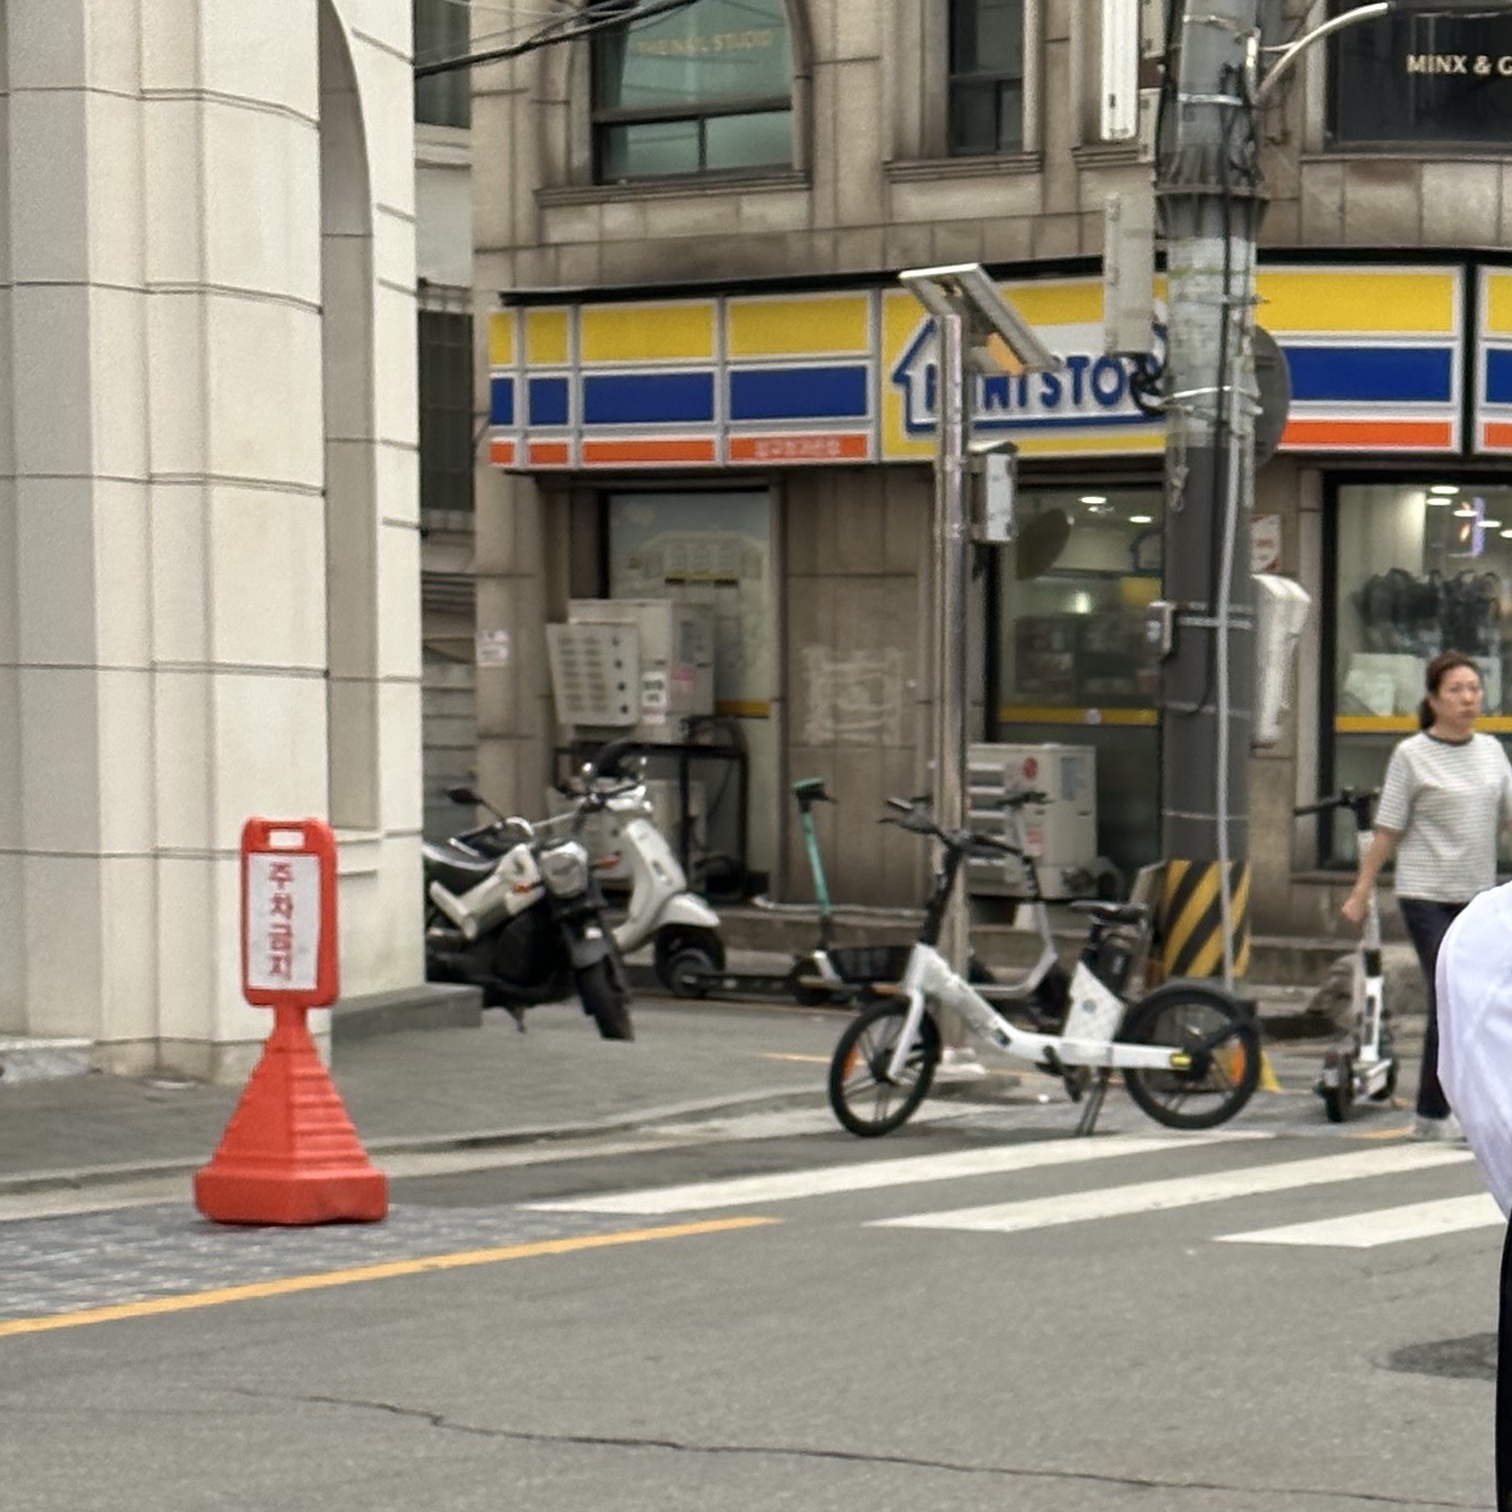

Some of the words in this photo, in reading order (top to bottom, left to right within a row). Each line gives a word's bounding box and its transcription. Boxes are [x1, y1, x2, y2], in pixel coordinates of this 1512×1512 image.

[1406, 54, 1467, 74] MINX
[1473, 54, 1492, 76] &
[267, 861, 294, 981] 주차금지
